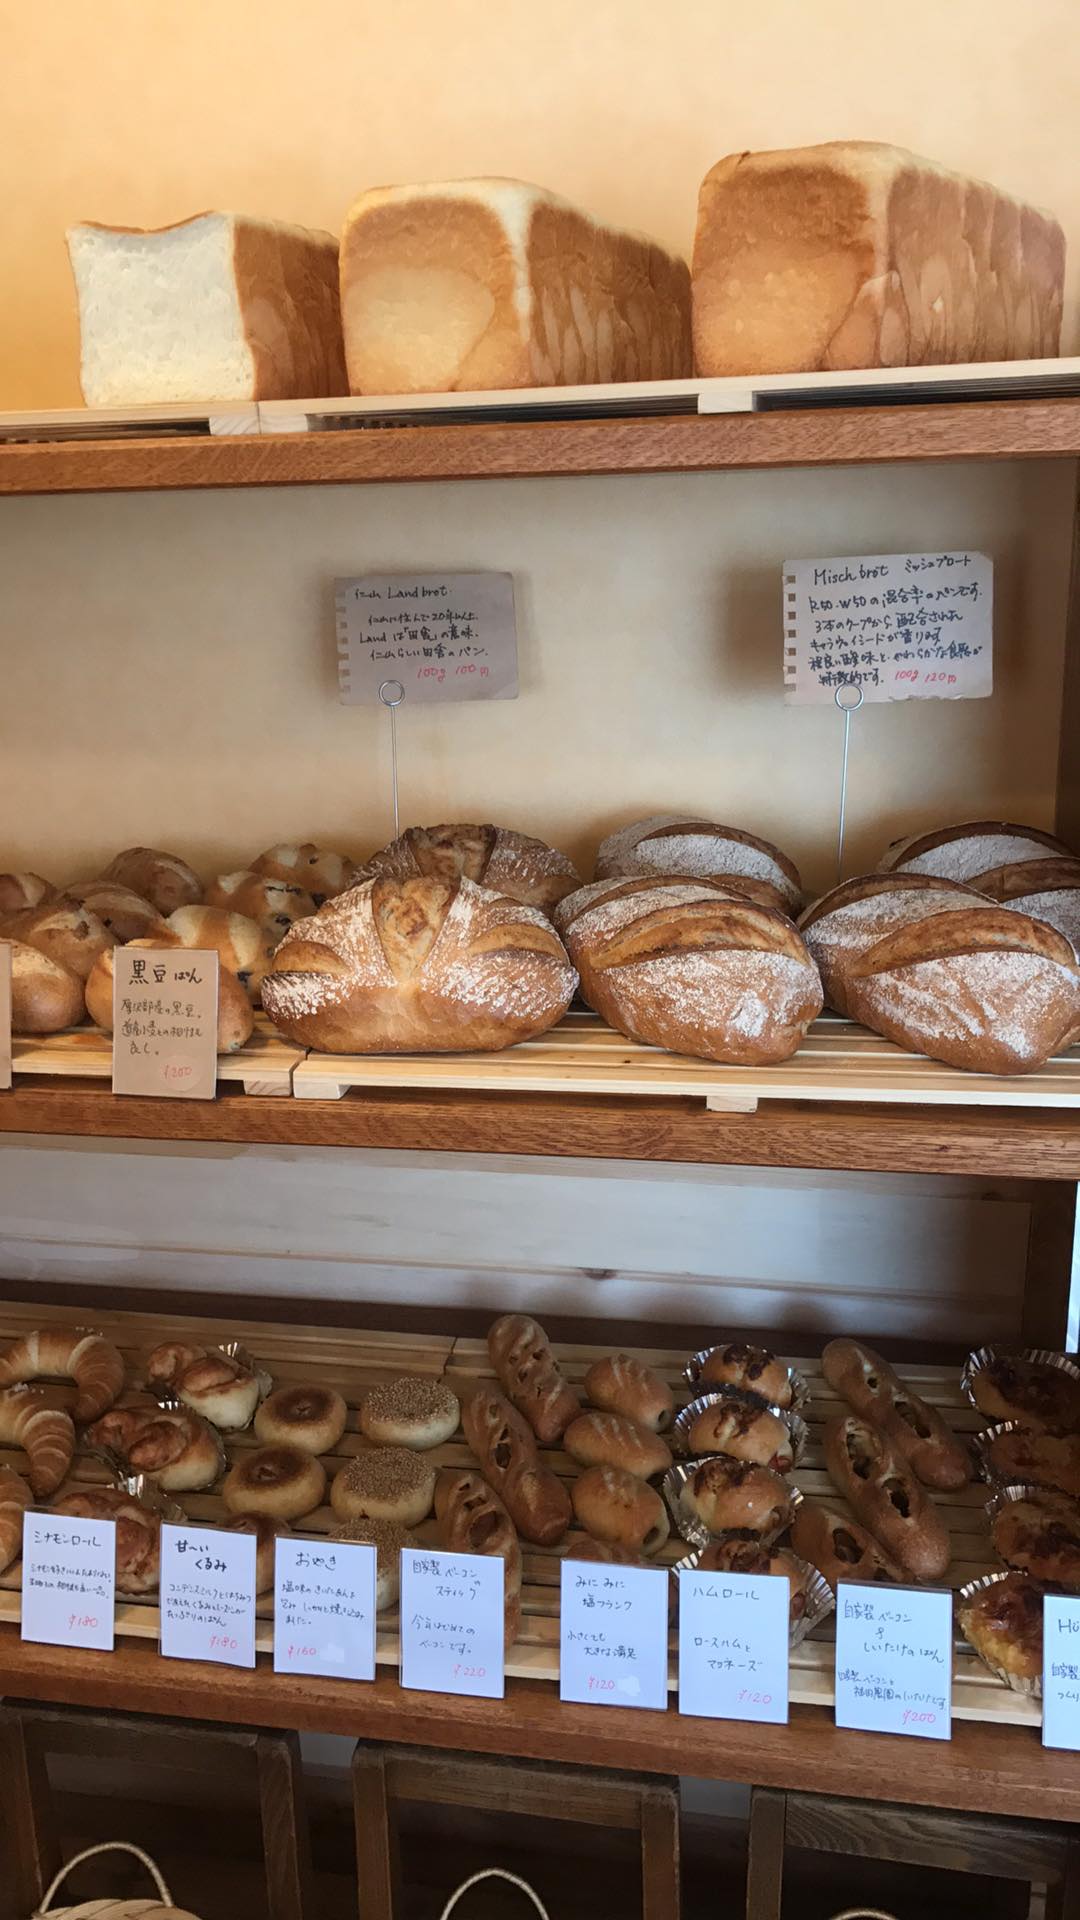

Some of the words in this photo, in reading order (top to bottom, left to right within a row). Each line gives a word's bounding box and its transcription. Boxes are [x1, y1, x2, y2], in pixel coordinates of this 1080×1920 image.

[813, 566, 857, 586] Misch
[859, 564, 889, 579] brot
[417, 665, 447, 682] 100g
[895, 669, 919, 682] 100g
[33, 1530, 102, 1547] シナモンロール
[195, 1557, 227, 1573] くるみ
[295, 1551, 337, 1571] おやき
[692, 1585, 760, 1600] ハムロール
[587, 1675, 616, 1691] ¥120
[902, 1710, 936, 1725] ¥200
